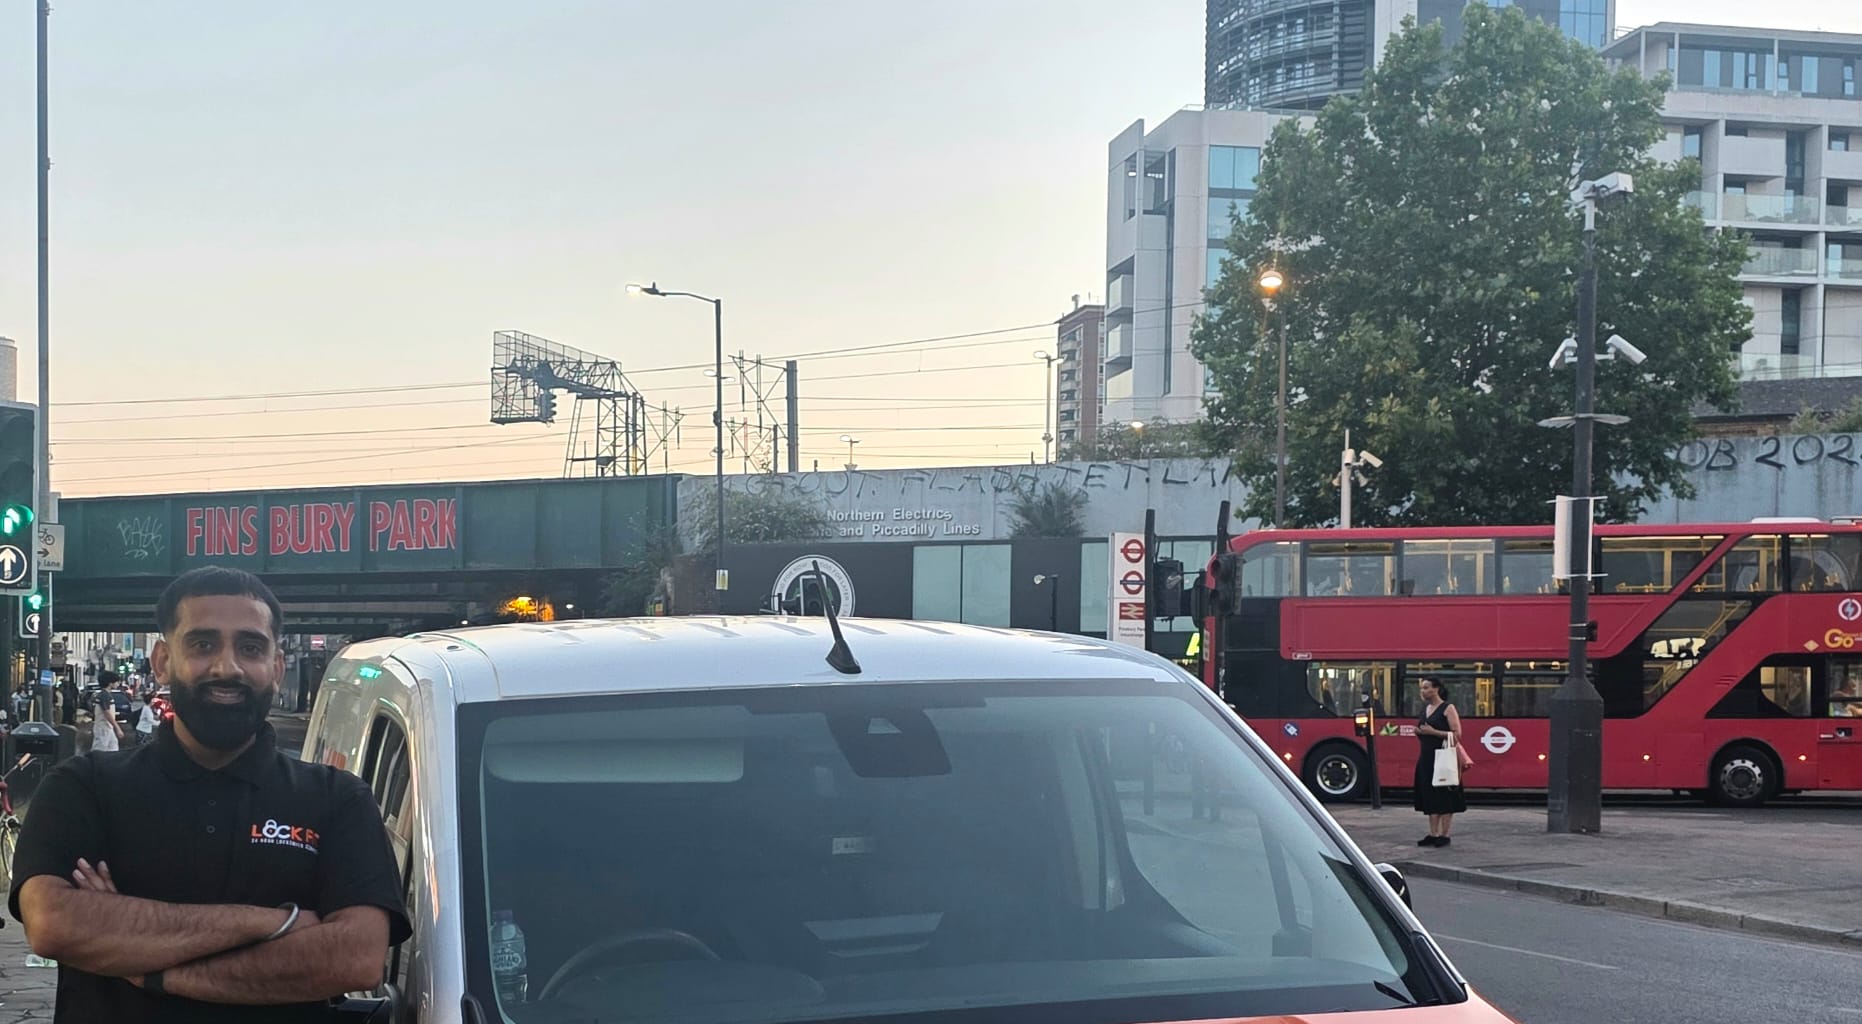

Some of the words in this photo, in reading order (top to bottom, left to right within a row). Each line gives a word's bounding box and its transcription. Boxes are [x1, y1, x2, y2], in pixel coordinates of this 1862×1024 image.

[1755, 434, 1862, 471] 202
[827, 509, 884, 521] Northern
[893, 508, 953, 521] Electrics
[185, 506, 258, 557] FINS
[270, 502, 355, 555] BURY
[369, 498, 456, 552] PARK
[839, 523, 864, 537] and
[872, 522, 936, 538] Piccadilly
[943, 522, 980, 536] Lines
[1825, 628, 1854, 648] Go
